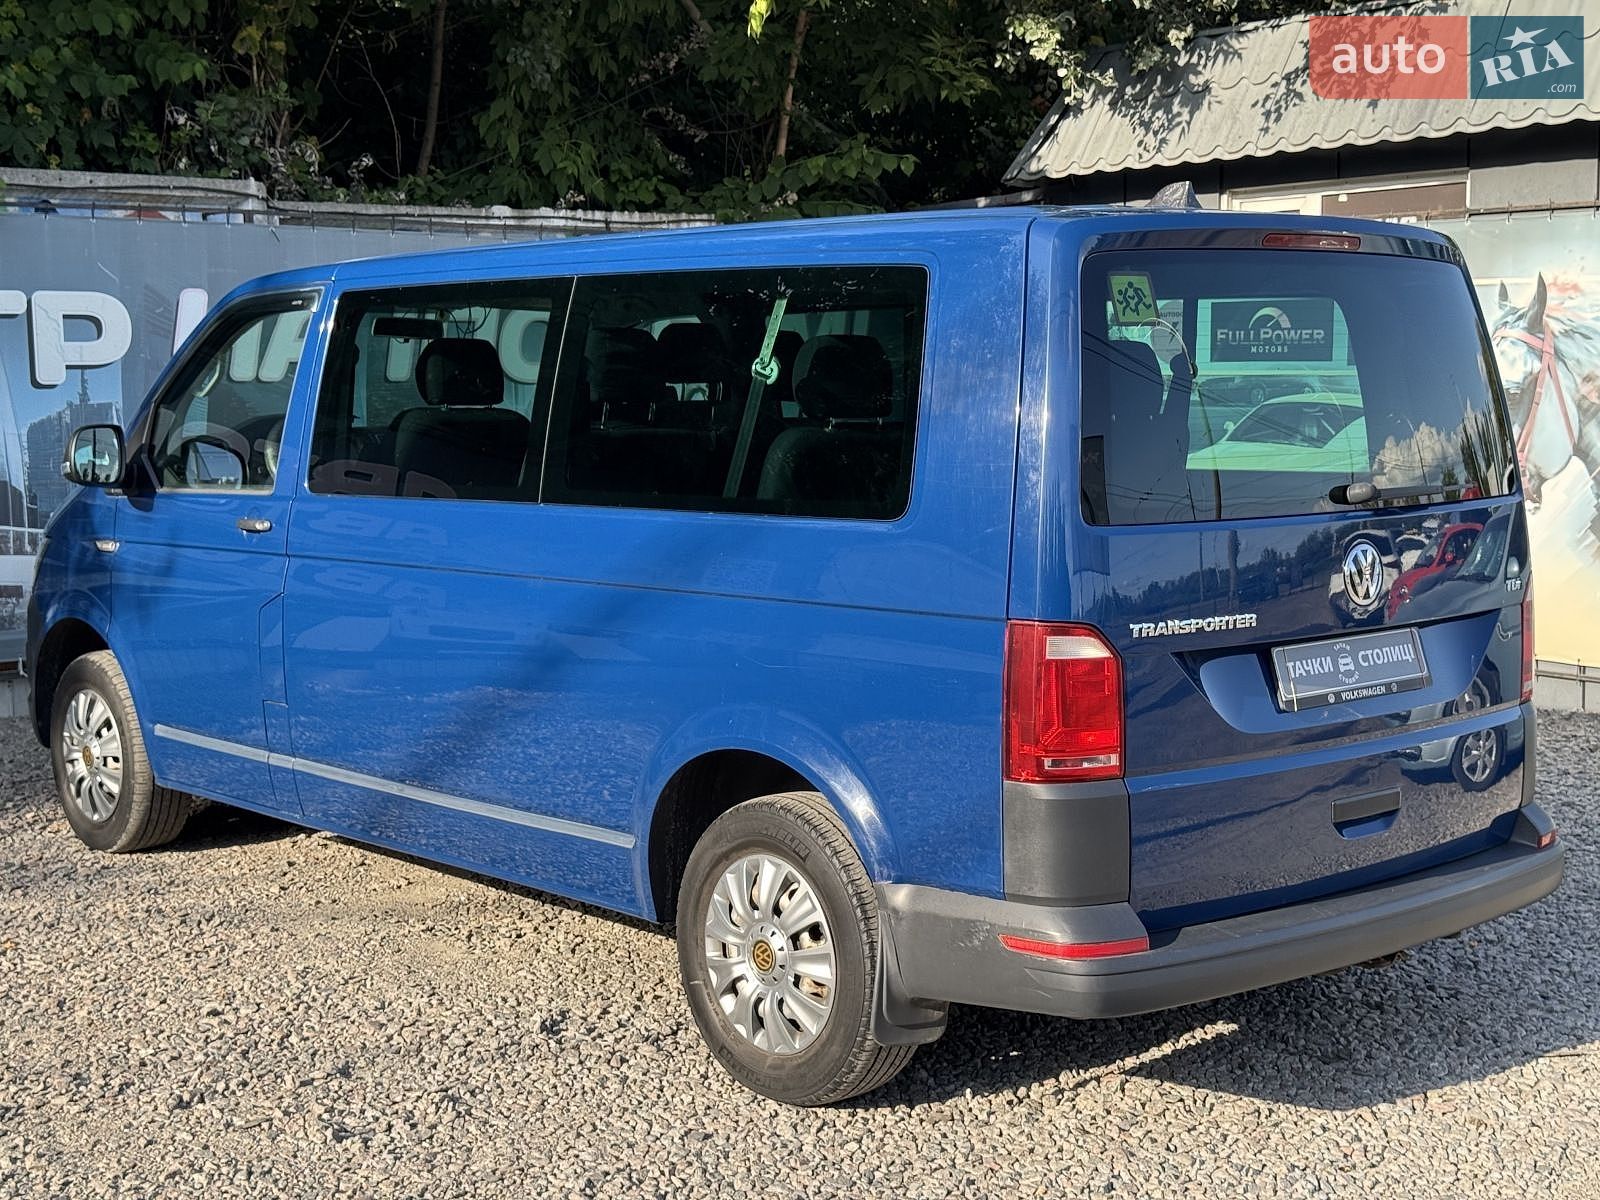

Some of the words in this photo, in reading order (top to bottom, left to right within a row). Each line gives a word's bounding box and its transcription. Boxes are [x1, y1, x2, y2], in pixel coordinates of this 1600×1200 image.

[1250, 345, 1289, 353] MOTORS
[1129, 613, 1258, 638] TRANSPORTER
[1286, 654, 1334, 679] ТАЧКИ
[1358, 643, 1415, 667] СТОЛИЦІ
[1341, 685, 1387, 701] VOLKSWAGEN
